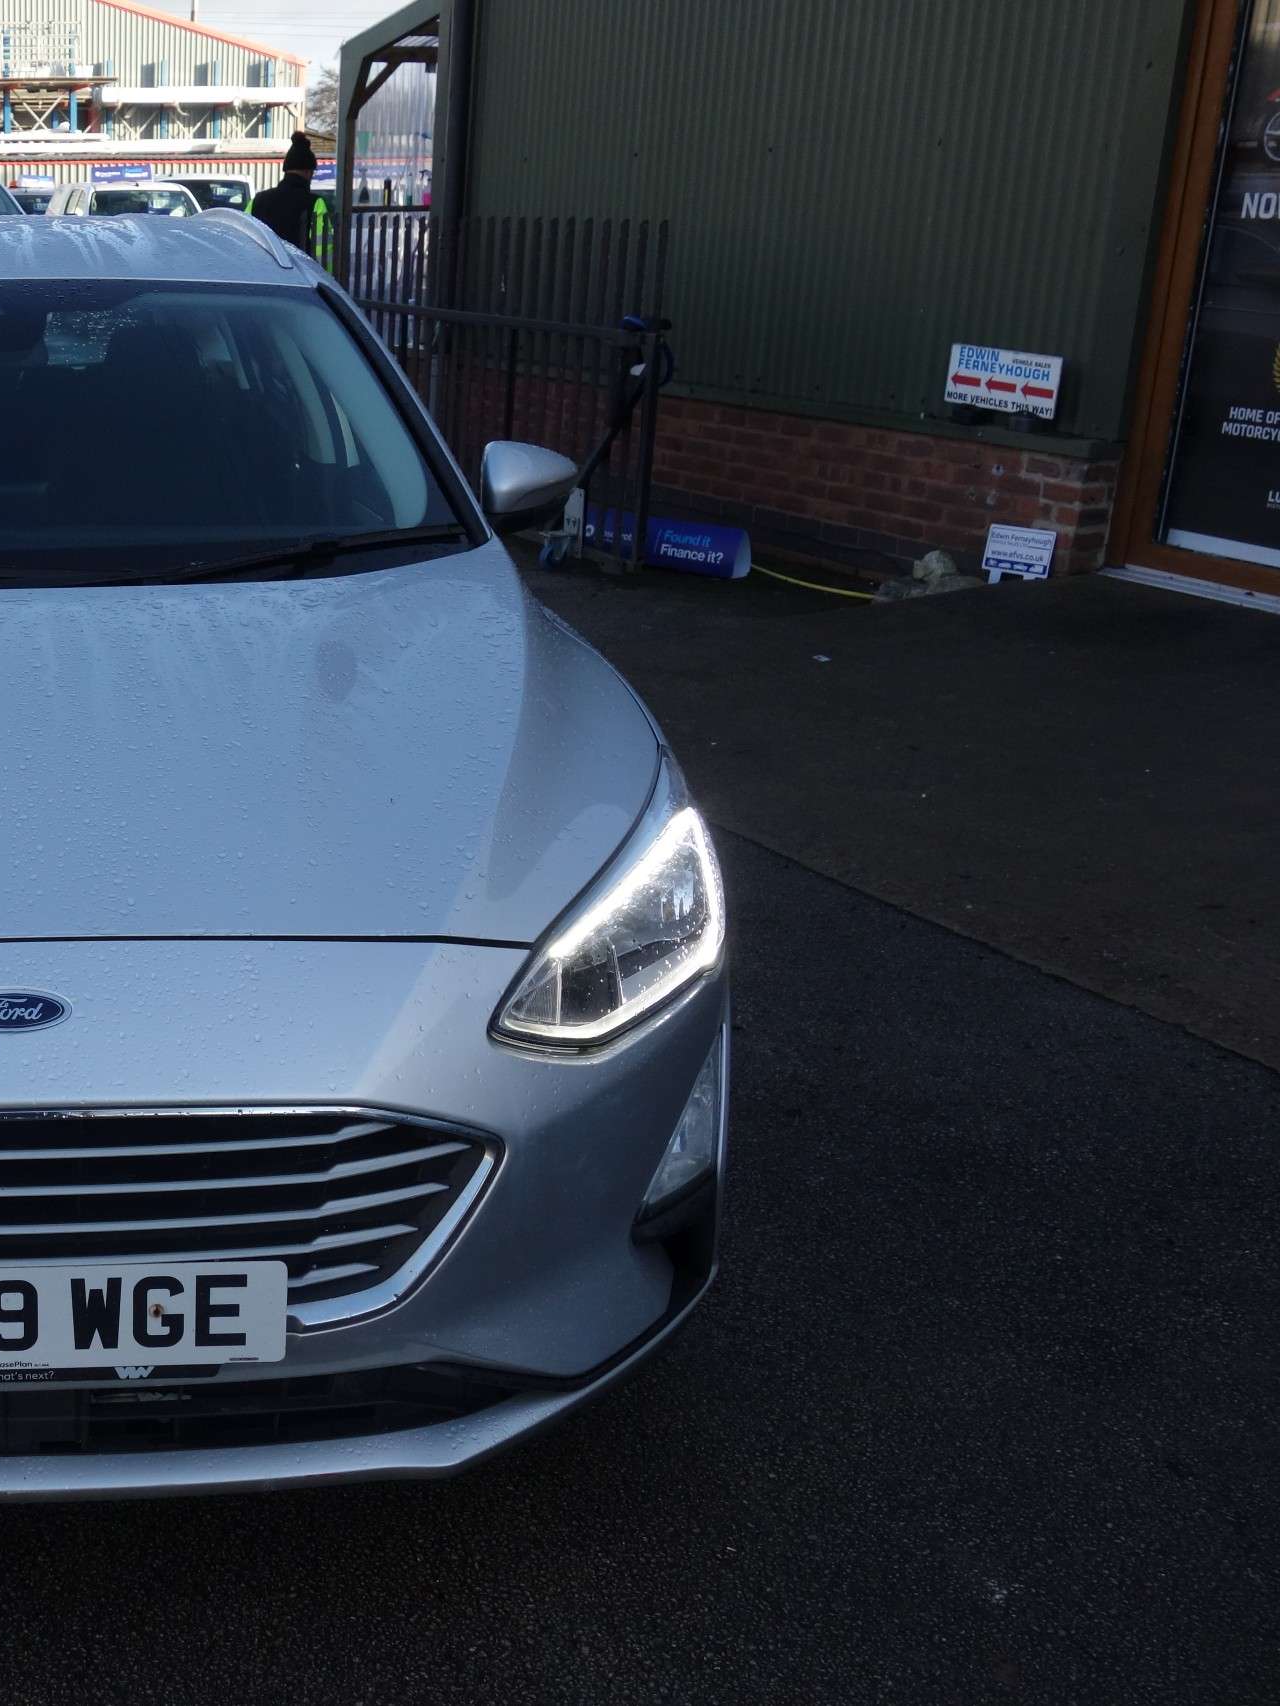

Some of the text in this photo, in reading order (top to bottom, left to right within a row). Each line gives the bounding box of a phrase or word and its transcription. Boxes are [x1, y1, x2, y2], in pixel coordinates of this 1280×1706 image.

[960, 346, 1000, 362] EDWIN
[958, 359, 1051, 381] FERNEYHOUGH
[946, 391, 1053, 417] MORE VEHICLES THIS WAY!
[1229, 406, 1265, 423] HOME
[664, 530, 711, 548] Found it
[660, 544, 724, 564] Finance it?
[70, 1274, 248, 1351] WGE
[25, 1370, 55, 1381] next?
